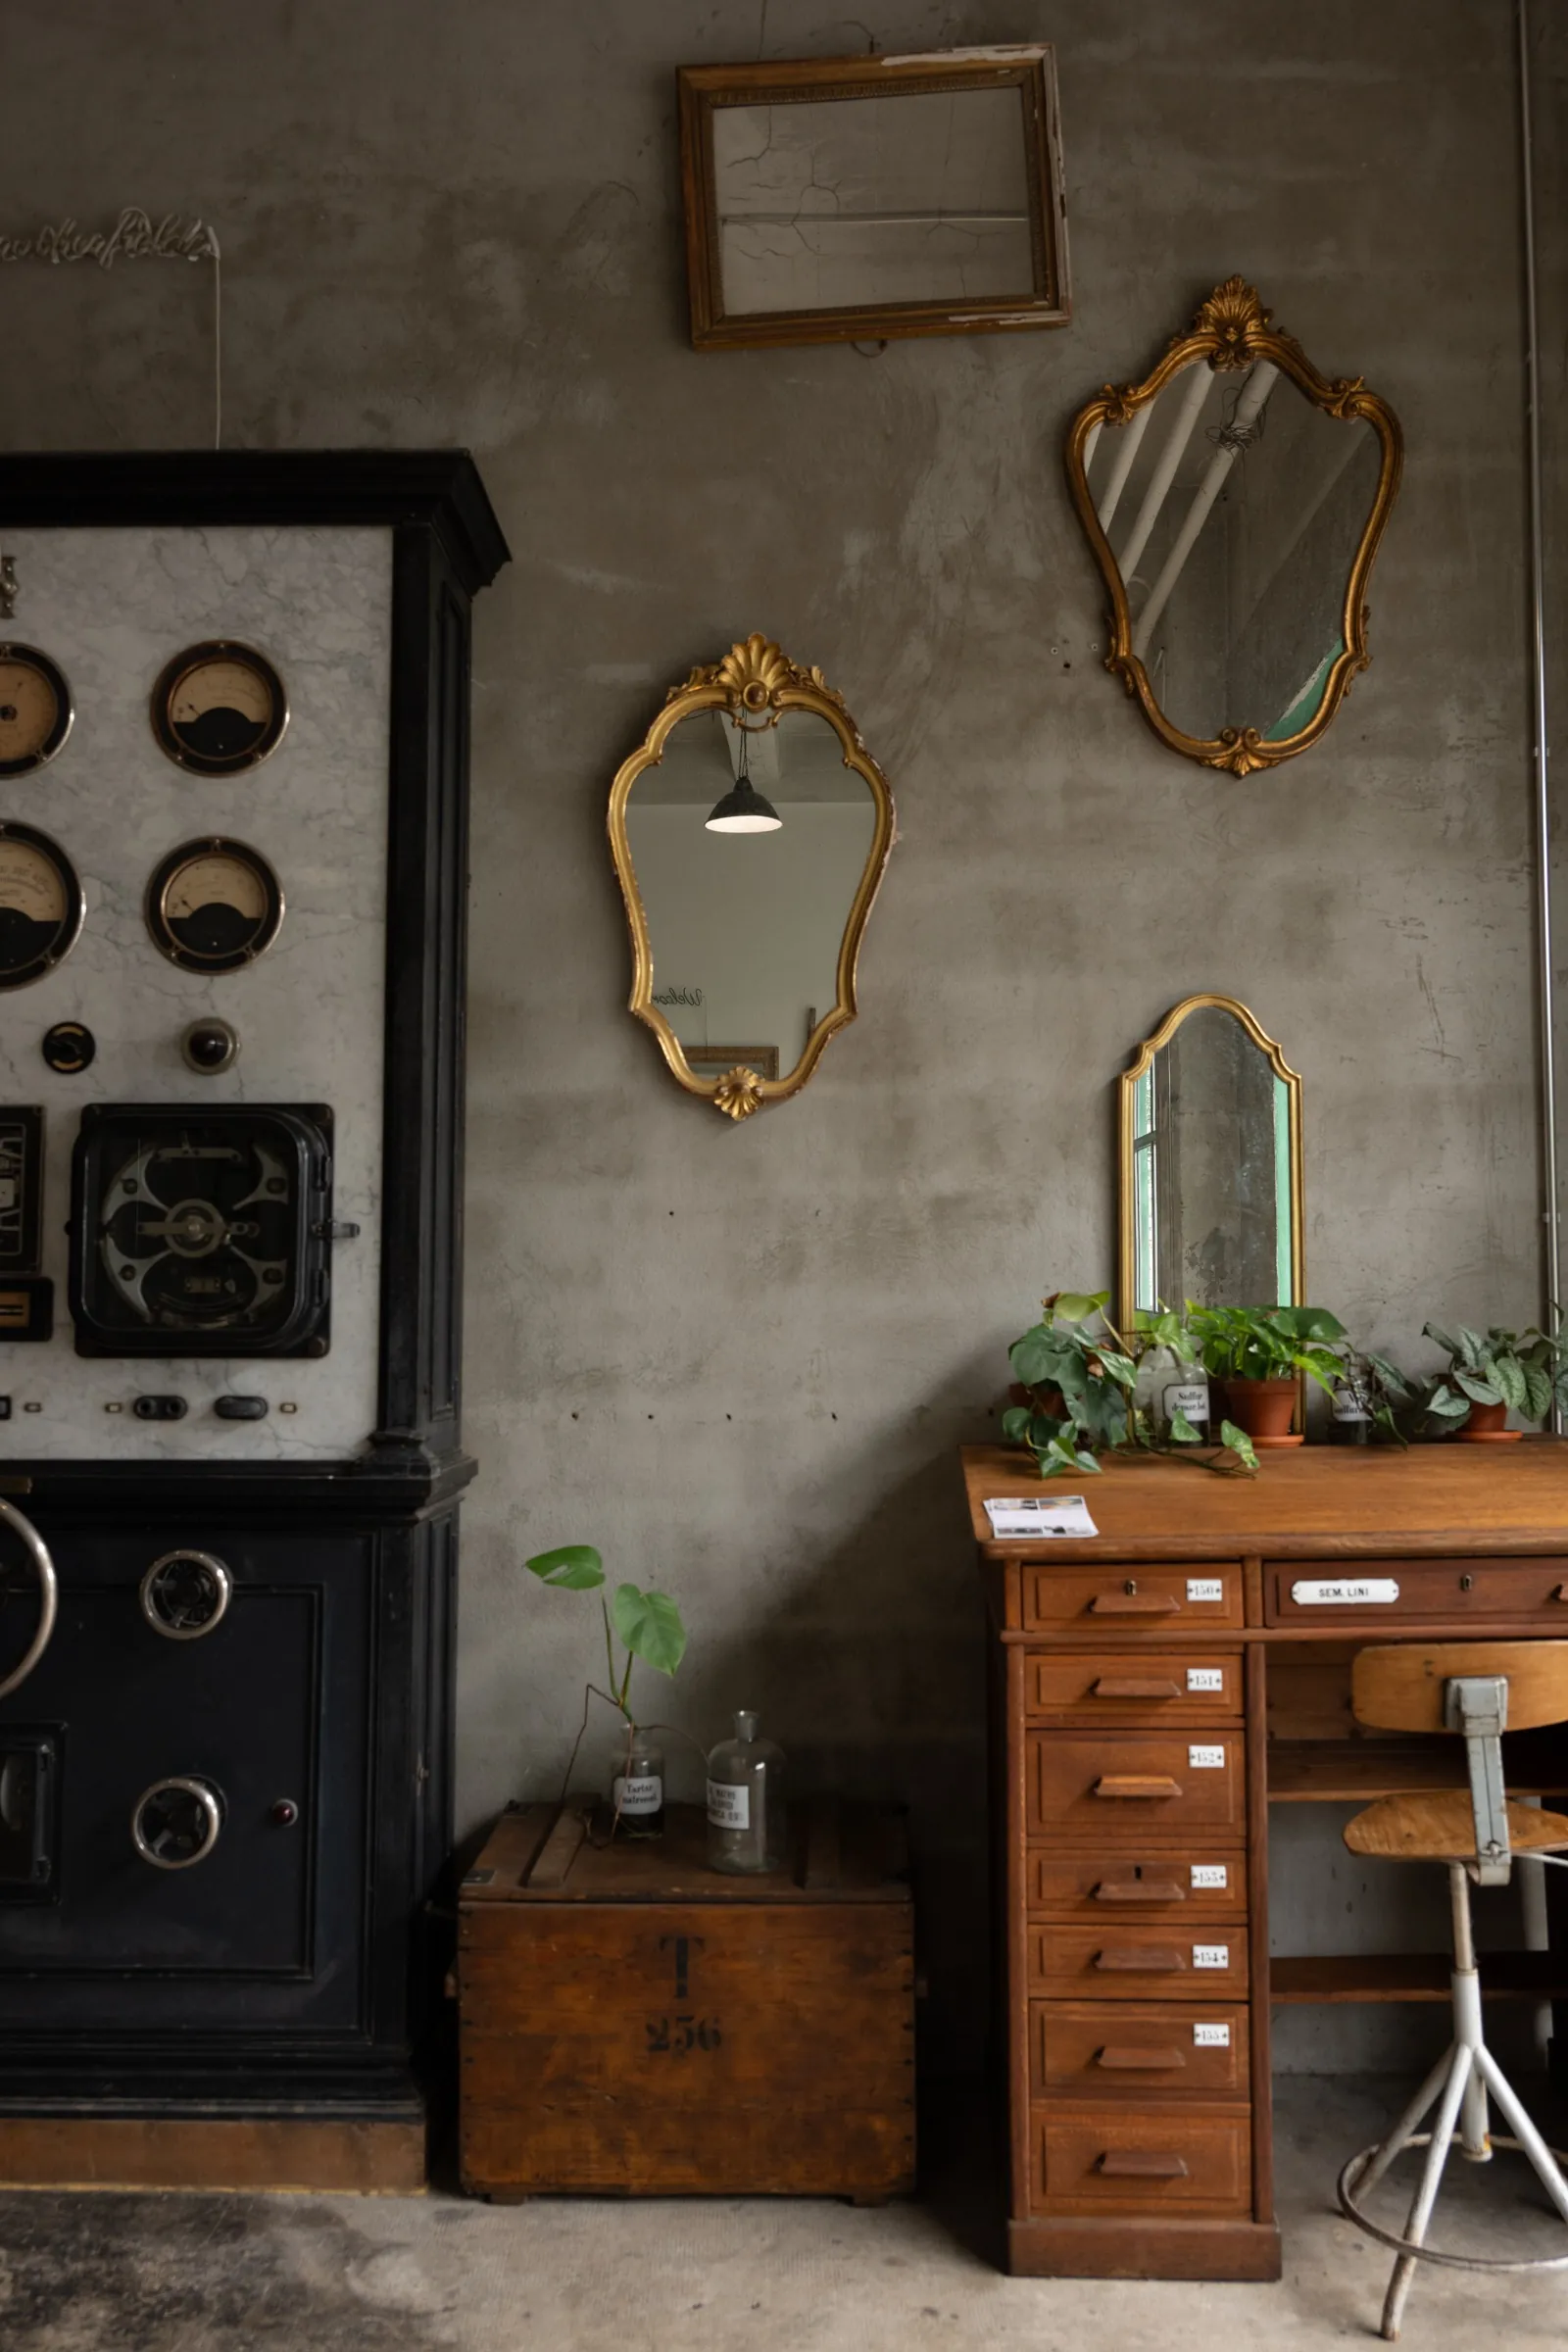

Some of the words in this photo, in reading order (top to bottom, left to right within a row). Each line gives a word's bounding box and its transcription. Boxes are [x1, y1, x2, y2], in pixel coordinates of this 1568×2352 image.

[1194, 1584, 1214, 1596] 150
[1347, 1587, 1369, 1597] LINI
[1196, 1675, 1213, 1687] 151
[1197, 1751, 1215, 1764] 152
[1200, 1951, 1218, 1963] 154
[659, 1936, 706, 1998] T
[645, 2015, 723, 2052] 256
[1201, 2030, 1220, 2041] 155
